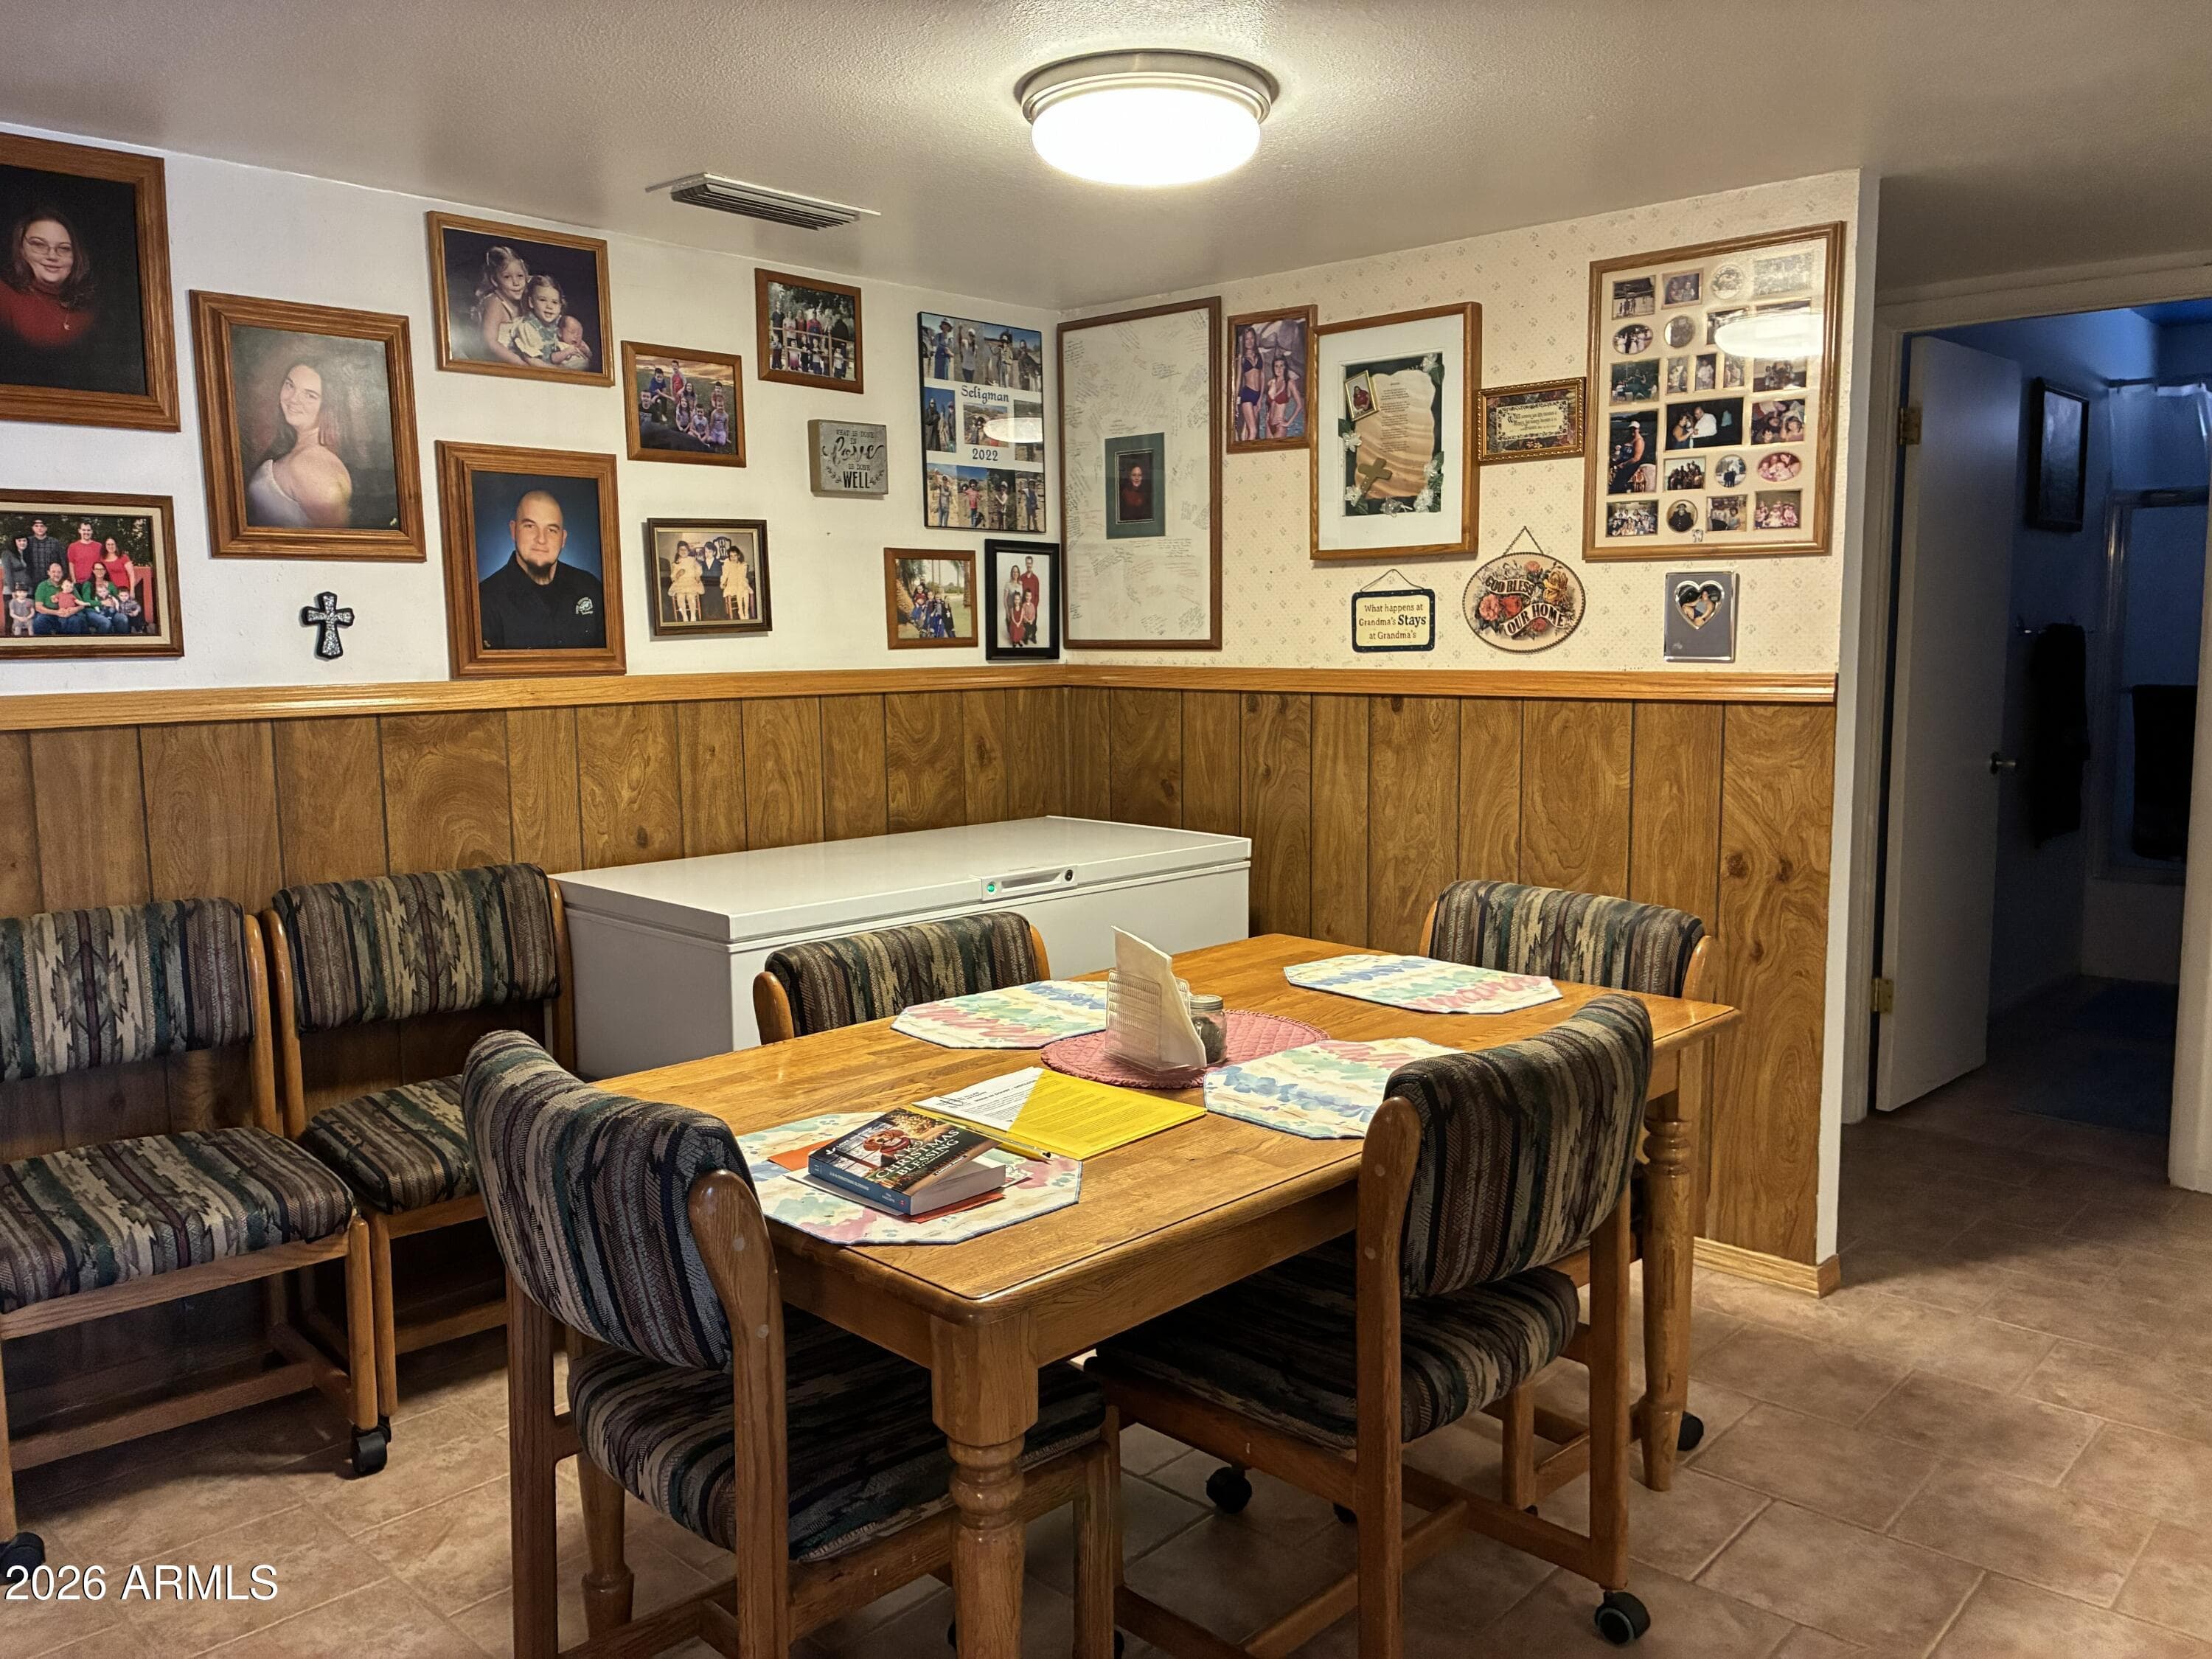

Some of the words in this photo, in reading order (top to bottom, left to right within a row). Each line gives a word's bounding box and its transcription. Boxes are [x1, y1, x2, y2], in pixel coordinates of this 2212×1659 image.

[961, 385, 1009, 404] Seligman
[972, 448, 999, 462] 2022
[843, 471, 870, 488] WELL
[1485, 576, 1505, 593] GOD
[1506, 580, 1534, 596] BLESS
[1364, 604, 1382, 613] What
[1384, 603, 1414, 613] happens
[1359, 617, 1397, 626] Grandma's
[1397, 614, 1427, 628] Stays
[1507, 611, 1531, 633] OUR
[1531, 604, 1565, 627] HOME
[1377, 630, 1416, 639] Grandma's
[875, 1130, 959, 1178] CHRISTMAS
[904, 1141, 923, 1152] K-9
[897, 1139, 959, 1176] BLESSING
